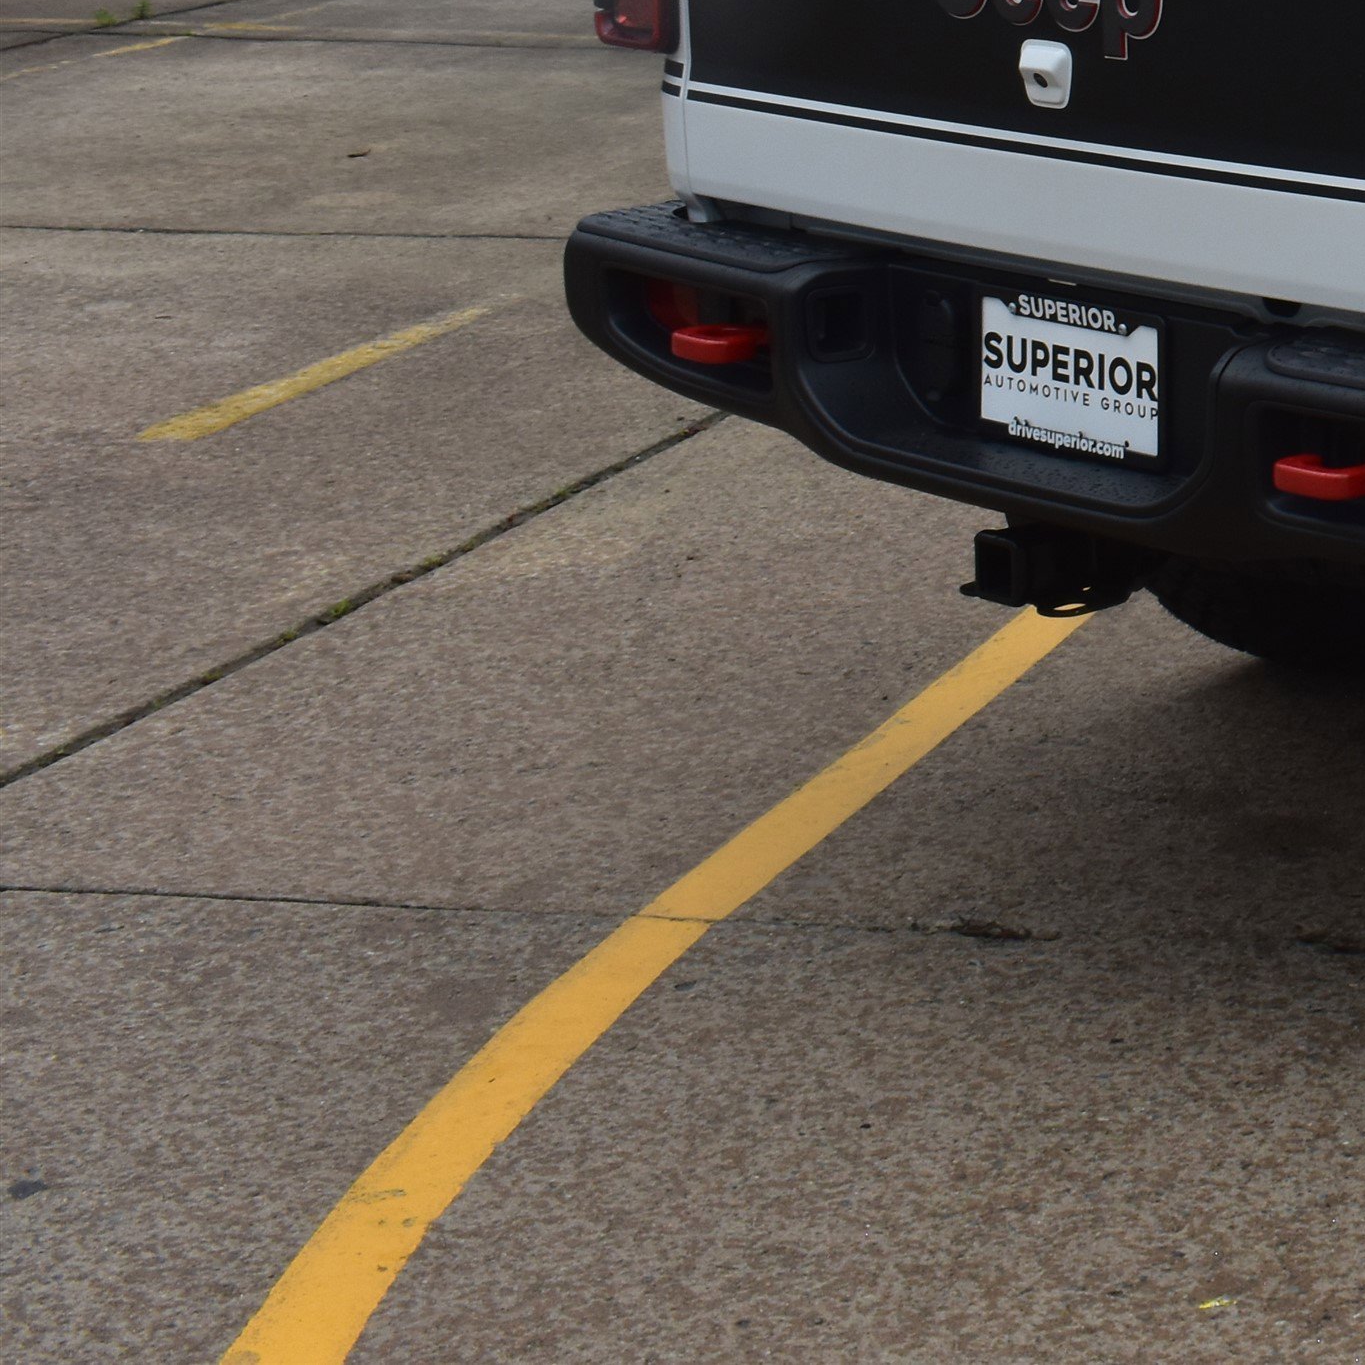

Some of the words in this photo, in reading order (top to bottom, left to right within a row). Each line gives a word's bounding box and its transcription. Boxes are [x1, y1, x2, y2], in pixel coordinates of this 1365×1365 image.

[1018, 294, 1117, 332] SUPERIOR
[984, 331, 1158, 402] SUPERIOR
[984, 374, 1090, 407] AUTOMOTIVE
[1101, 397, 1159, 421] GROUP
[1008, 418, 1125, 460] drivesuperior.com
